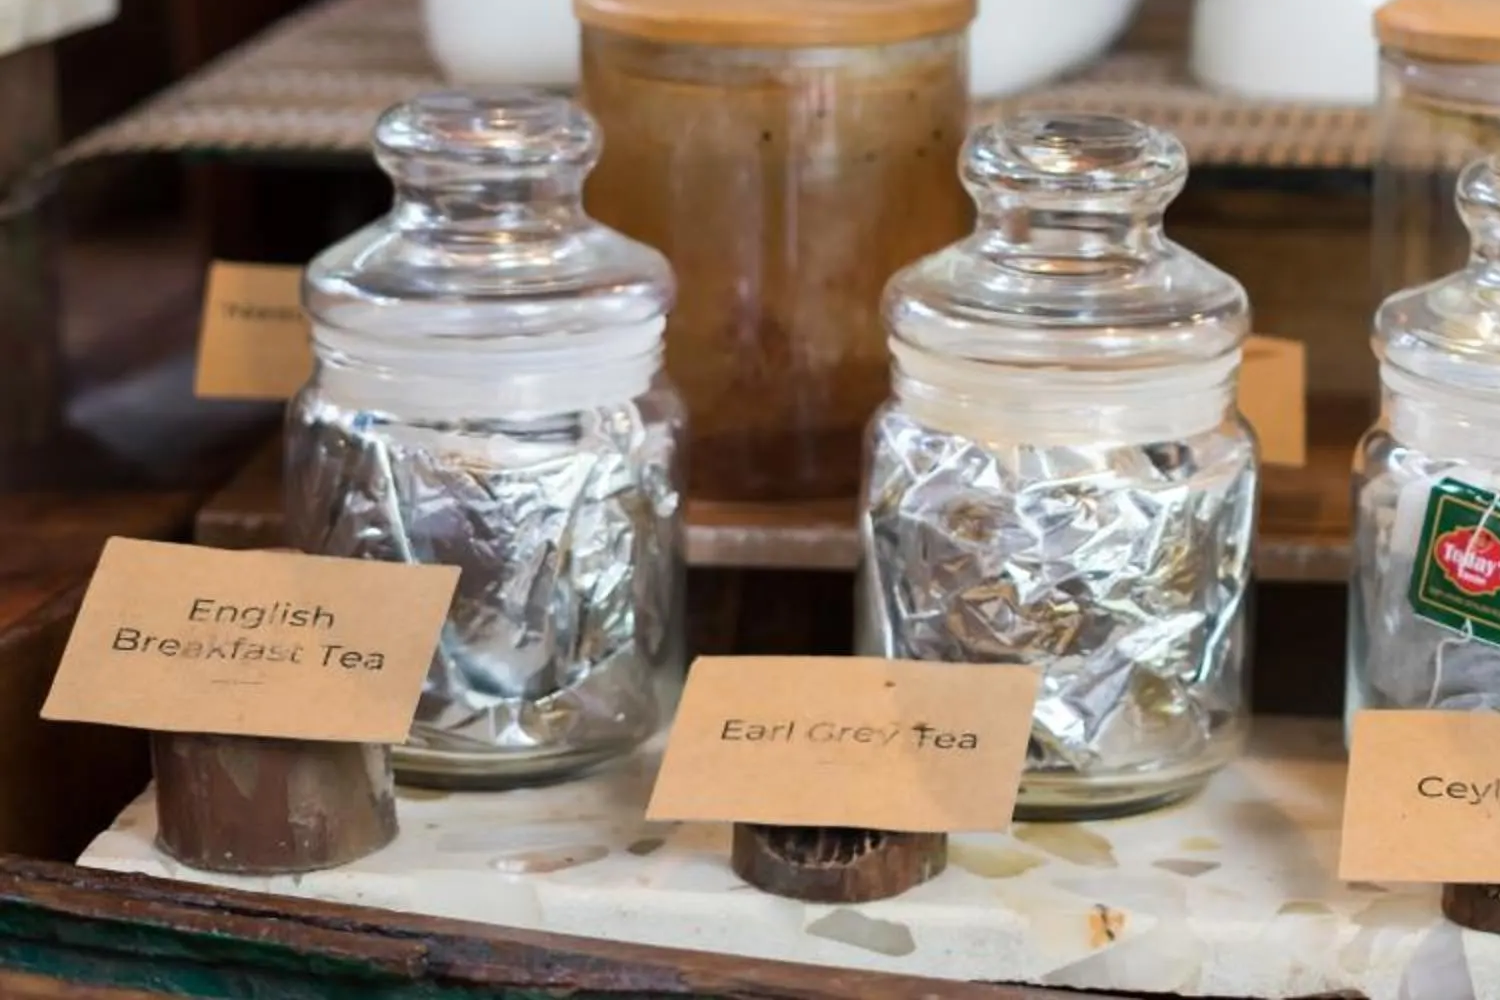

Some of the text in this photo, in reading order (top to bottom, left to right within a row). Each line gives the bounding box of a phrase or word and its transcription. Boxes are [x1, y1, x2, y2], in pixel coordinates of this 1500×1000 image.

[188, 598, 336, 630] English
[112, 627, 386, 671] Breakfast Tea
[720, 719, 978, 751] Earl Grey Tea
